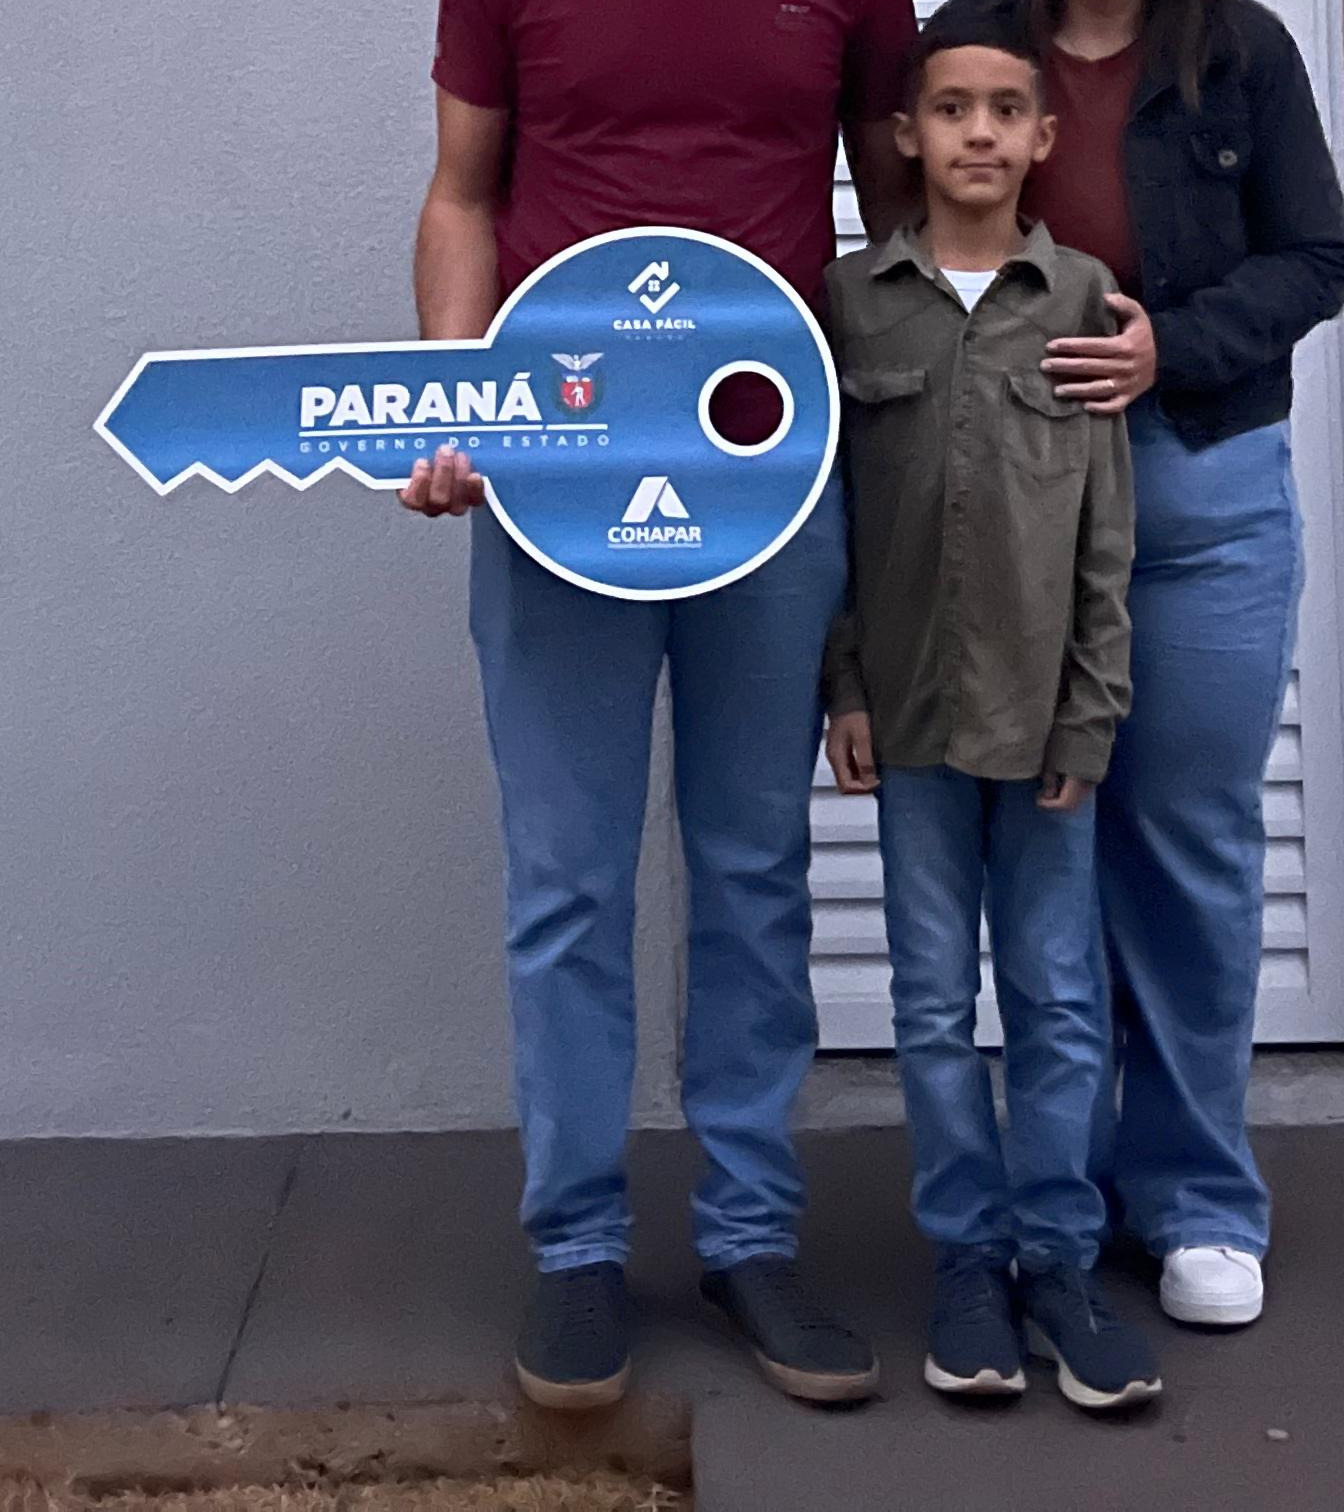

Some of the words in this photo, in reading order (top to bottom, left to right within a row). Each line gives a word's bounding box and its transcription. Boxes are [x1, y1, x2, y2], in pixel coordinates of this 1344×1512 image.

[613, 319, 651, 330] CASA
[656, 317, 696, 329] FÁCIL
[299, 372, 543, 427] PARANÁ
[299, 438, 426, 453] GOVERNO
[448, 436, 480, 448] DO
[503, 434, 610, 447] ESTADO
[607, 526, 702, 543] COHAPAR
